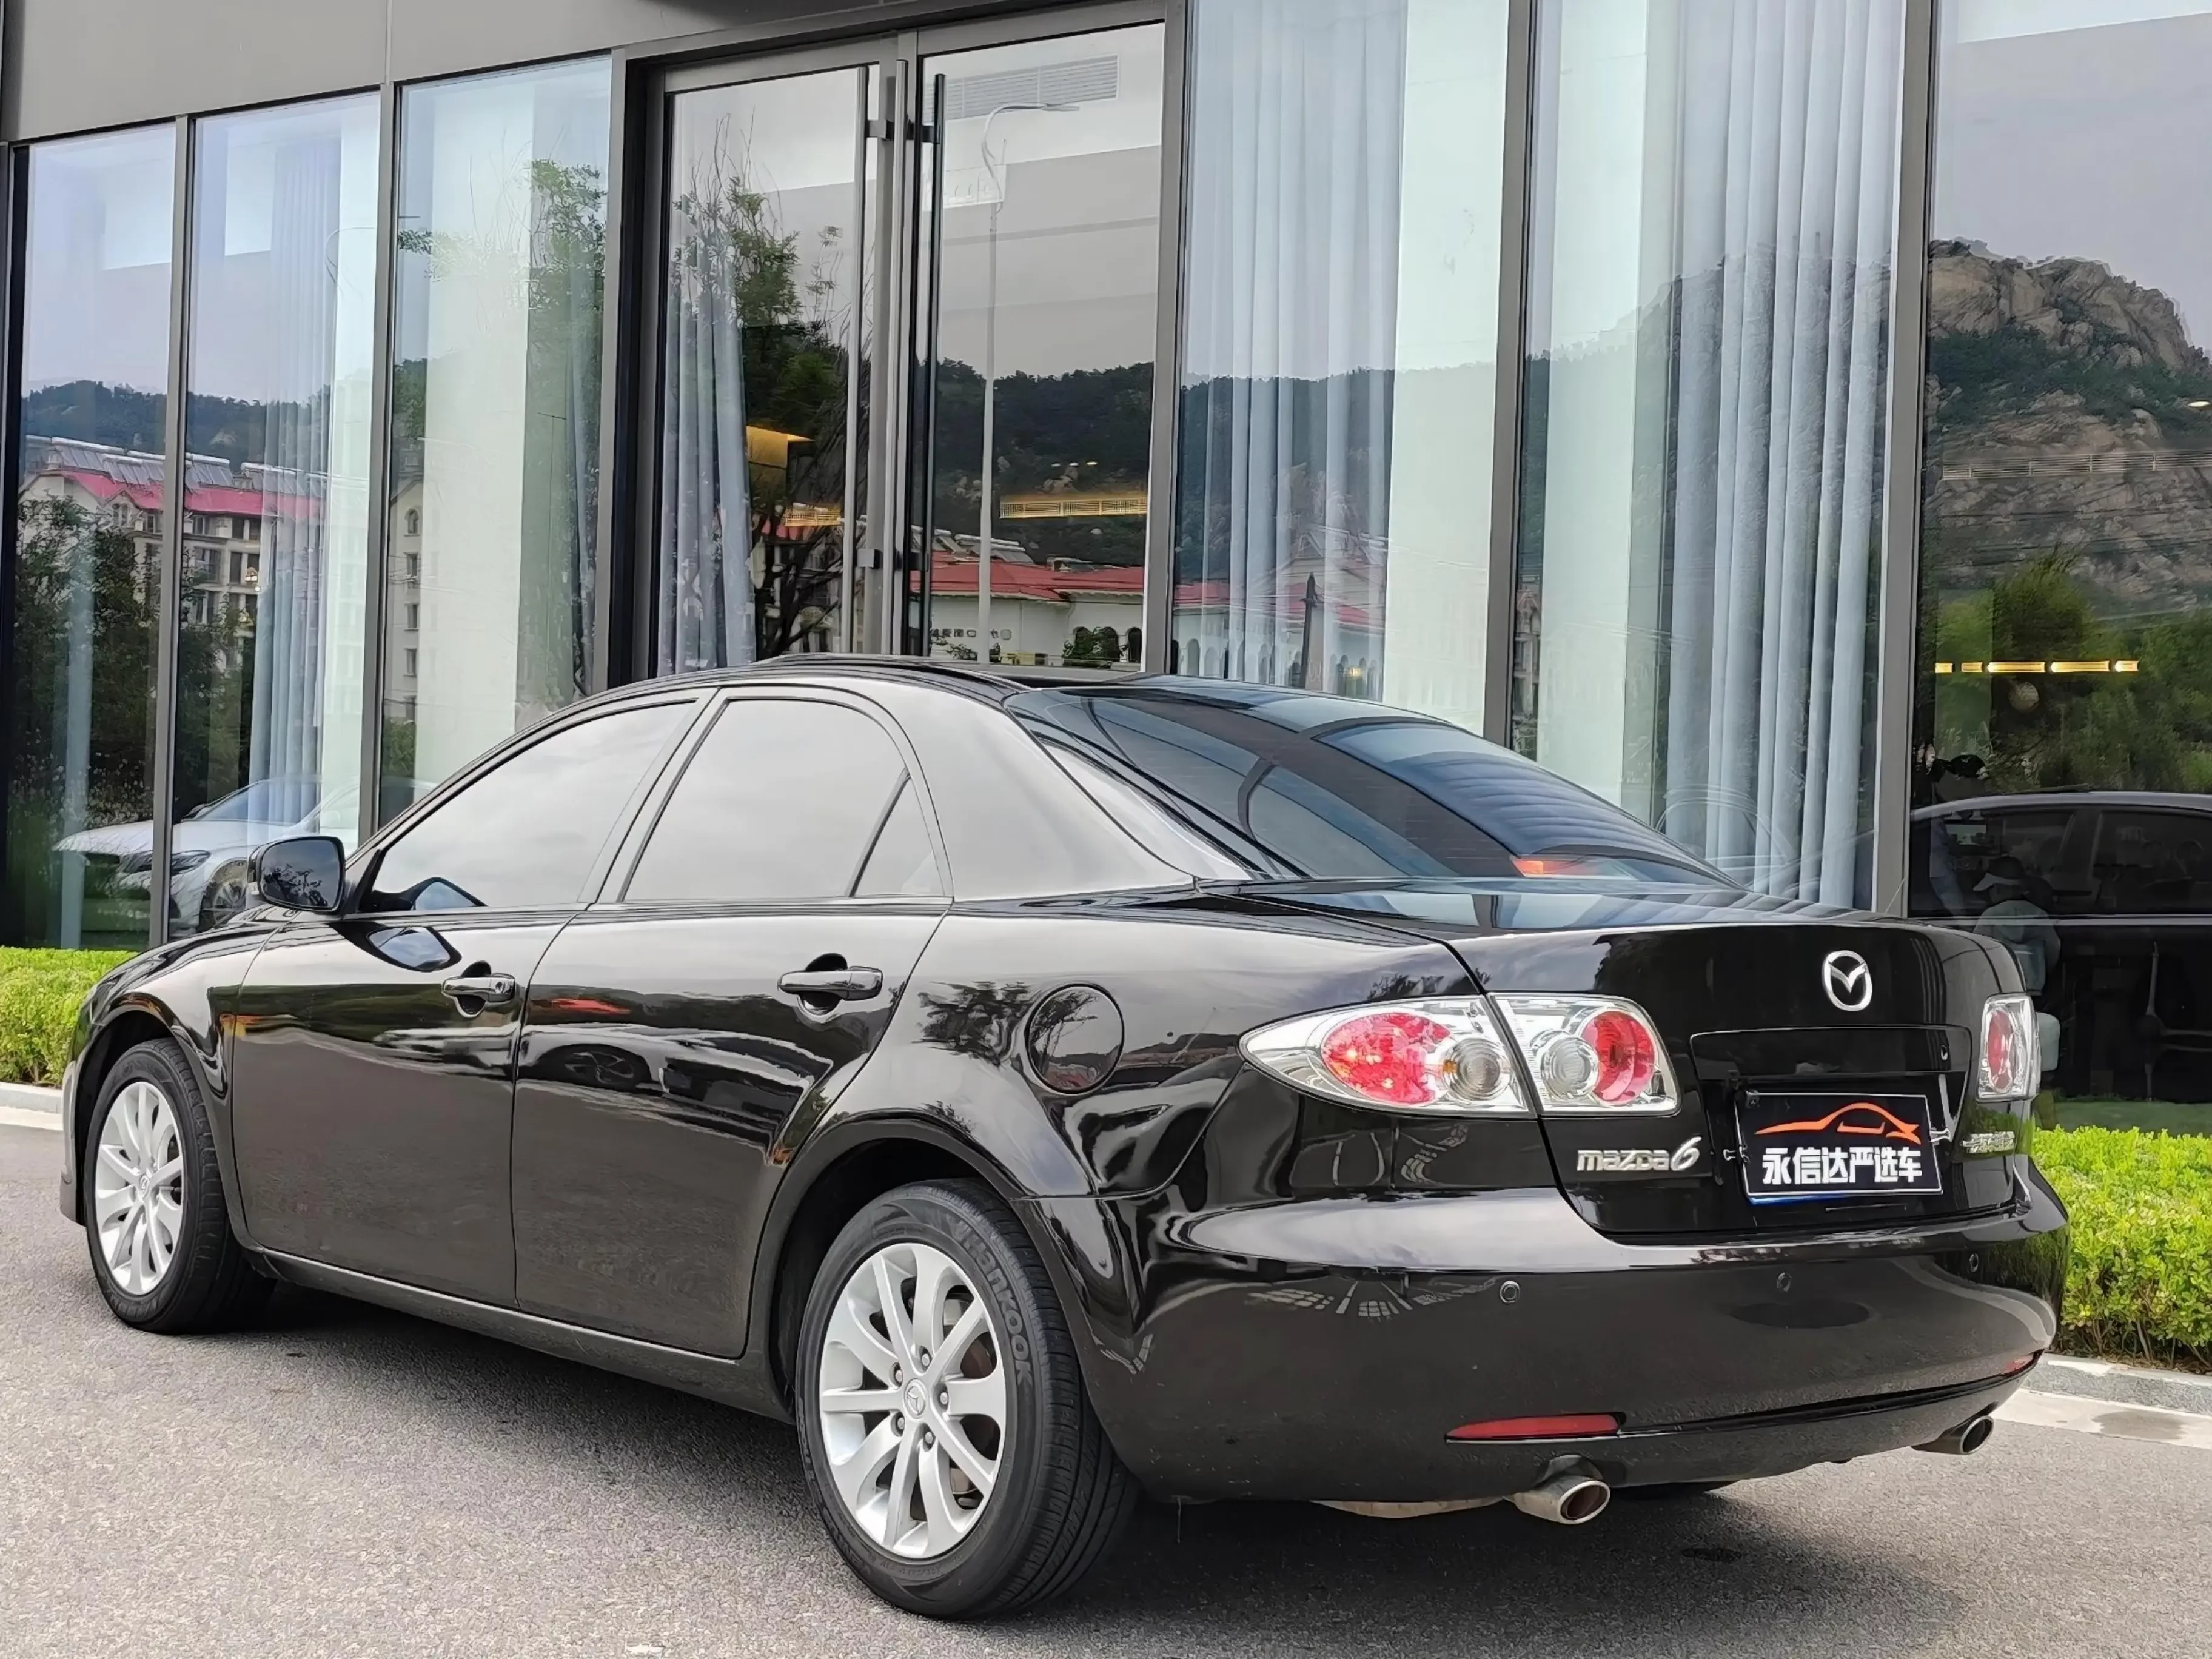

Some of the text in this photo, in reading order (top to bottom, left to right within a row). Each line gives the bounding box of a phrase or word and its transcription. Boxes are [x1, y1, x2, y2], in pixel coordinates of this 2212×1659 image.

[1762, 1147, 1922, 1184] 永信达严选车
